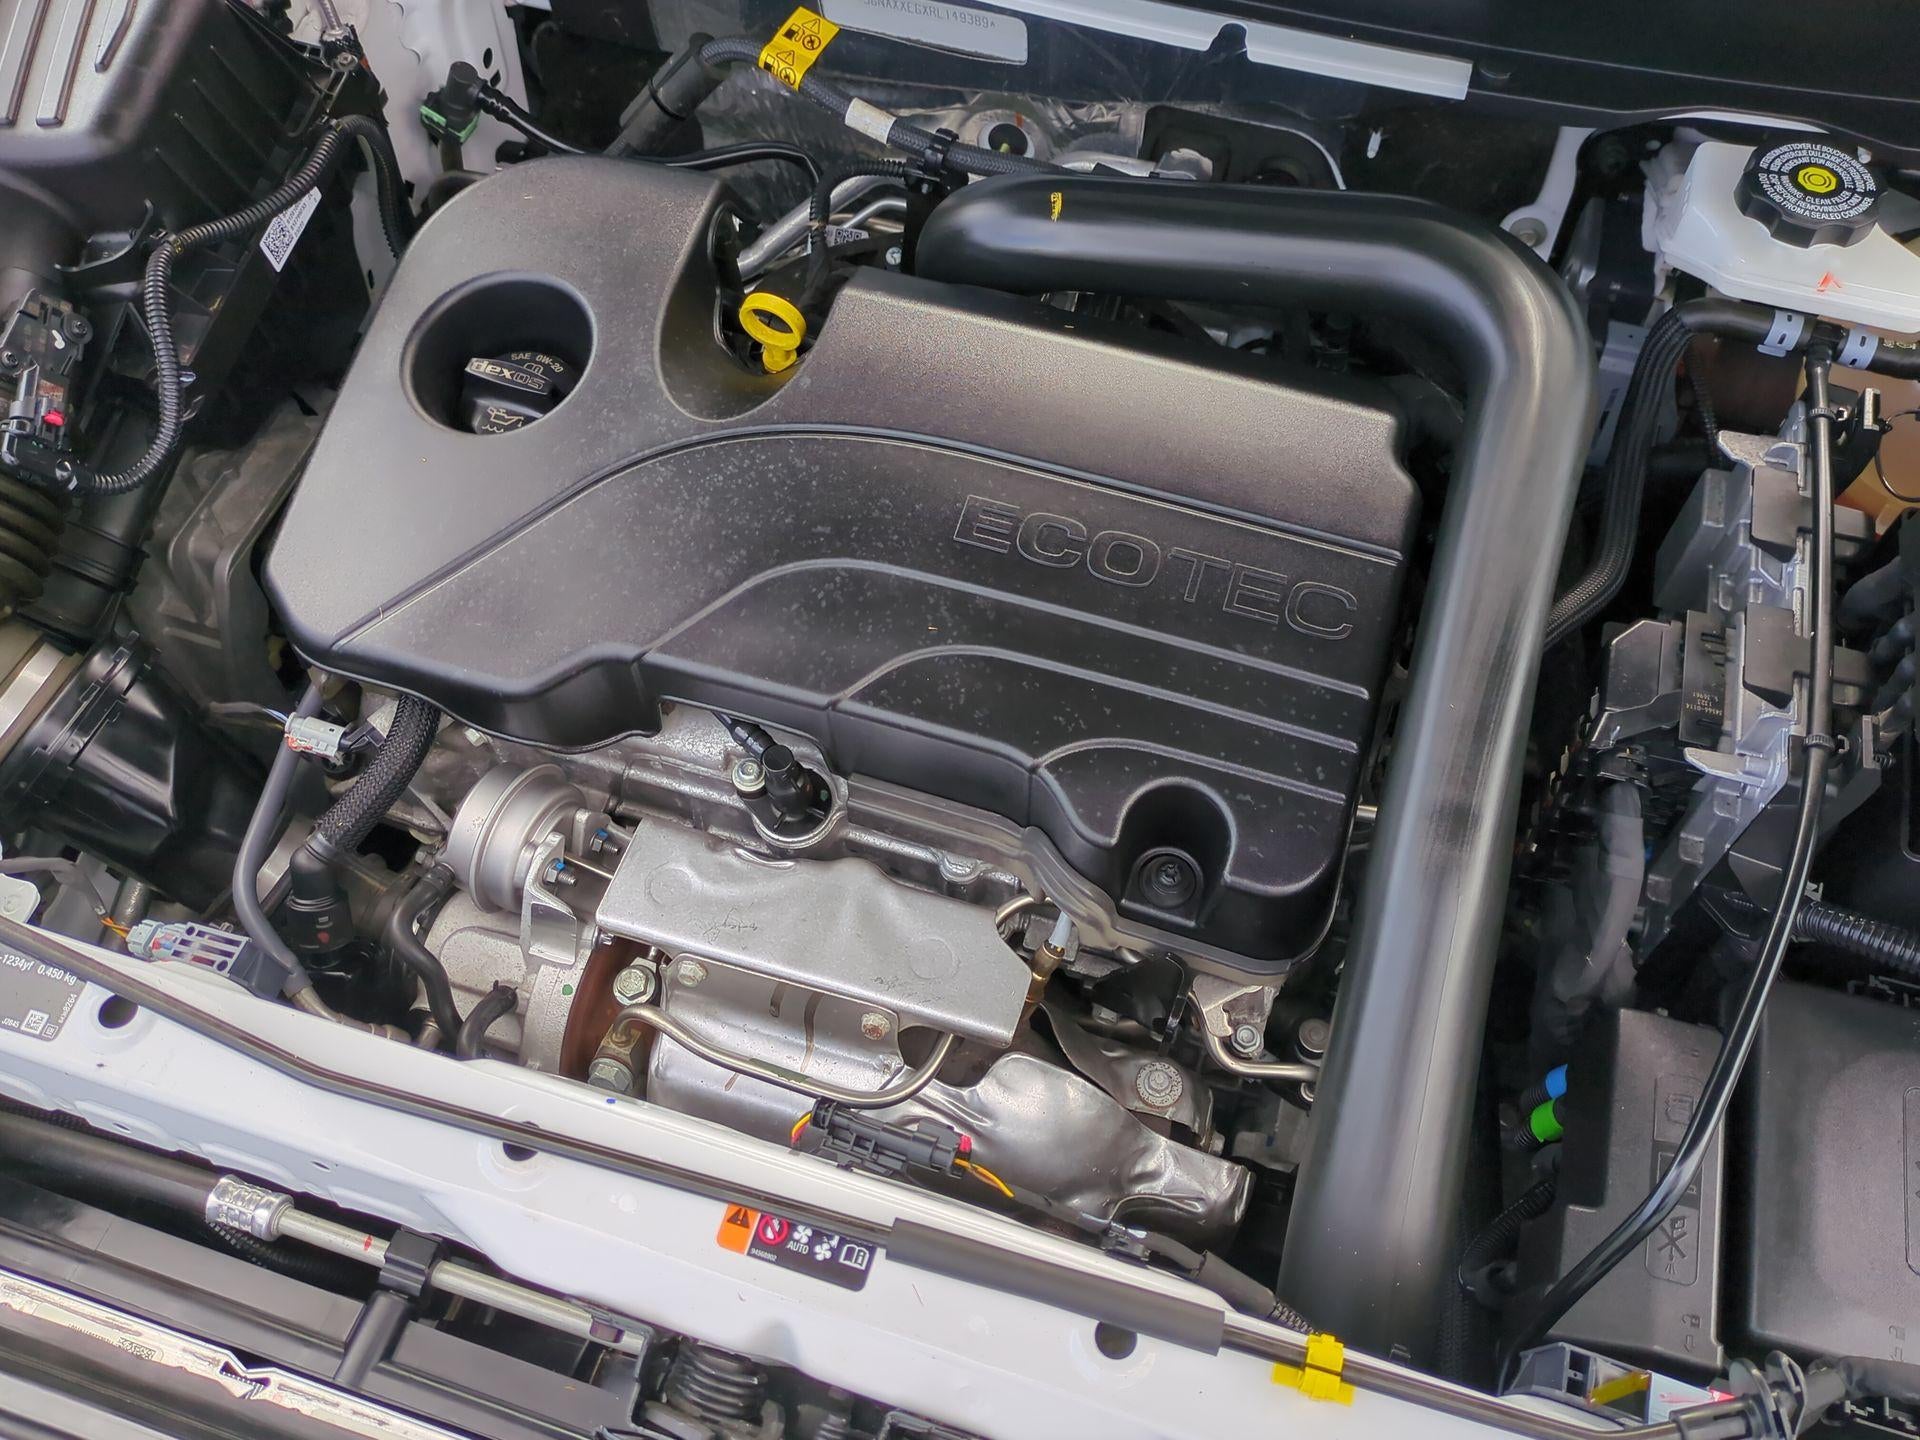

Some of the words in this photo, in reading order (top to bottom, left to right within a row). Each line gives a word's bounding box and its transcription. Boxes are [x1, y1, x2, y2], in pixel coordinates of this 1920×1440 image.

[1818, 151, 1843, 164] LIQUIDE
[1772, 184, 1798, 204] BEFORE
[1804, 196, 1833, 205] CLEAN
[1780, 200, 1804, 215] FROM
[1810, 211, 1842, 220] SEALED
[511, 352, 531, 361] SAE
[535, 354, 564, 373] 0W-20
[470, 360, 546, 390] dexos
[953, 494, 1358, 640] ECOTEC
[37, 964, 65, 981] 0.450
[63, 972, 77, 986] kg
[786, 1240, 810, 1255] AUTO
